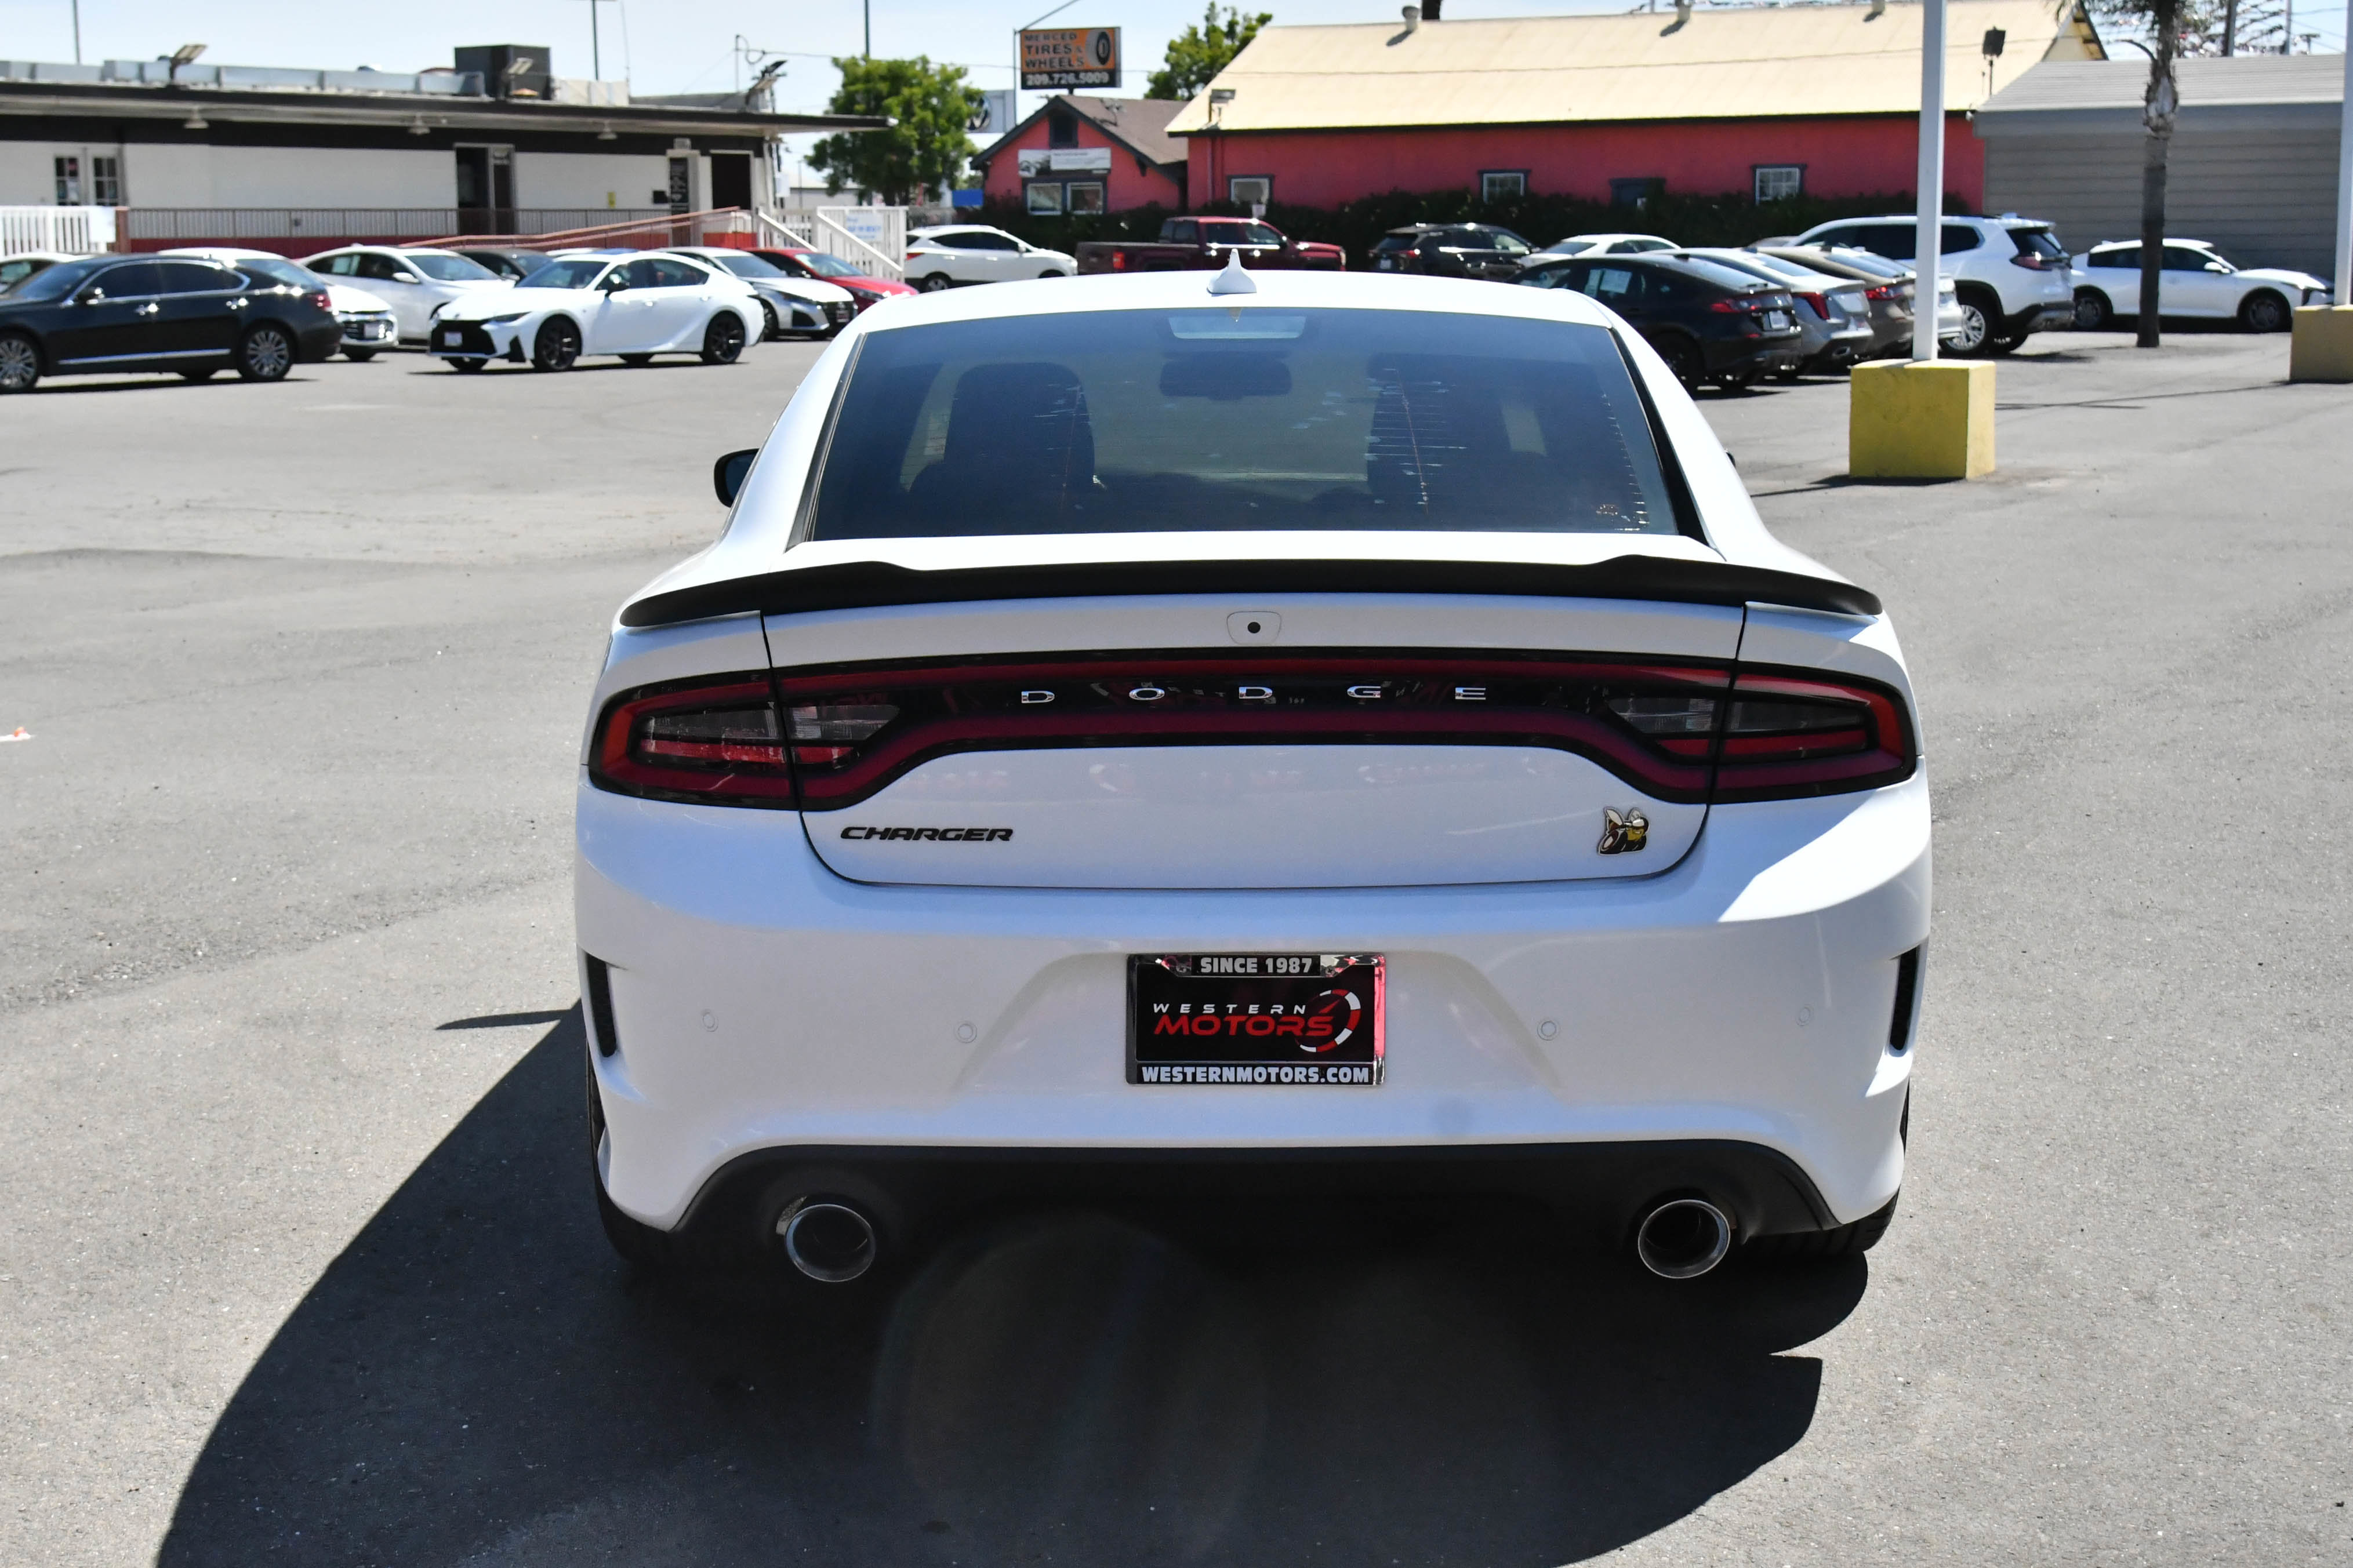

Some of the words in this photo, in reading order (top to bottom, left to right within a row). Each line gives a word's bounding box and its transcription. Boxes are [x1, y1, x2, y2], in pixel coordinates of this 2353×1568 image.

[1025, 43, 1072, 54] TIRES
[1025, 57, 1085, 68] WHEELS
[1021, 685, 1487, 704] DODGE
[841, 827, 1013, 841] CHARGER
[1200, 958, 1258, 973] SINCE
[1264, 958, 1313, 973] 1987
[1153, 1003, 1306, 1014] WESTERN
[1154, 1015, 1334, 1036] MOTORS
[1142, 1066, 1369, 1083] WESTERNMOTORS.COM
